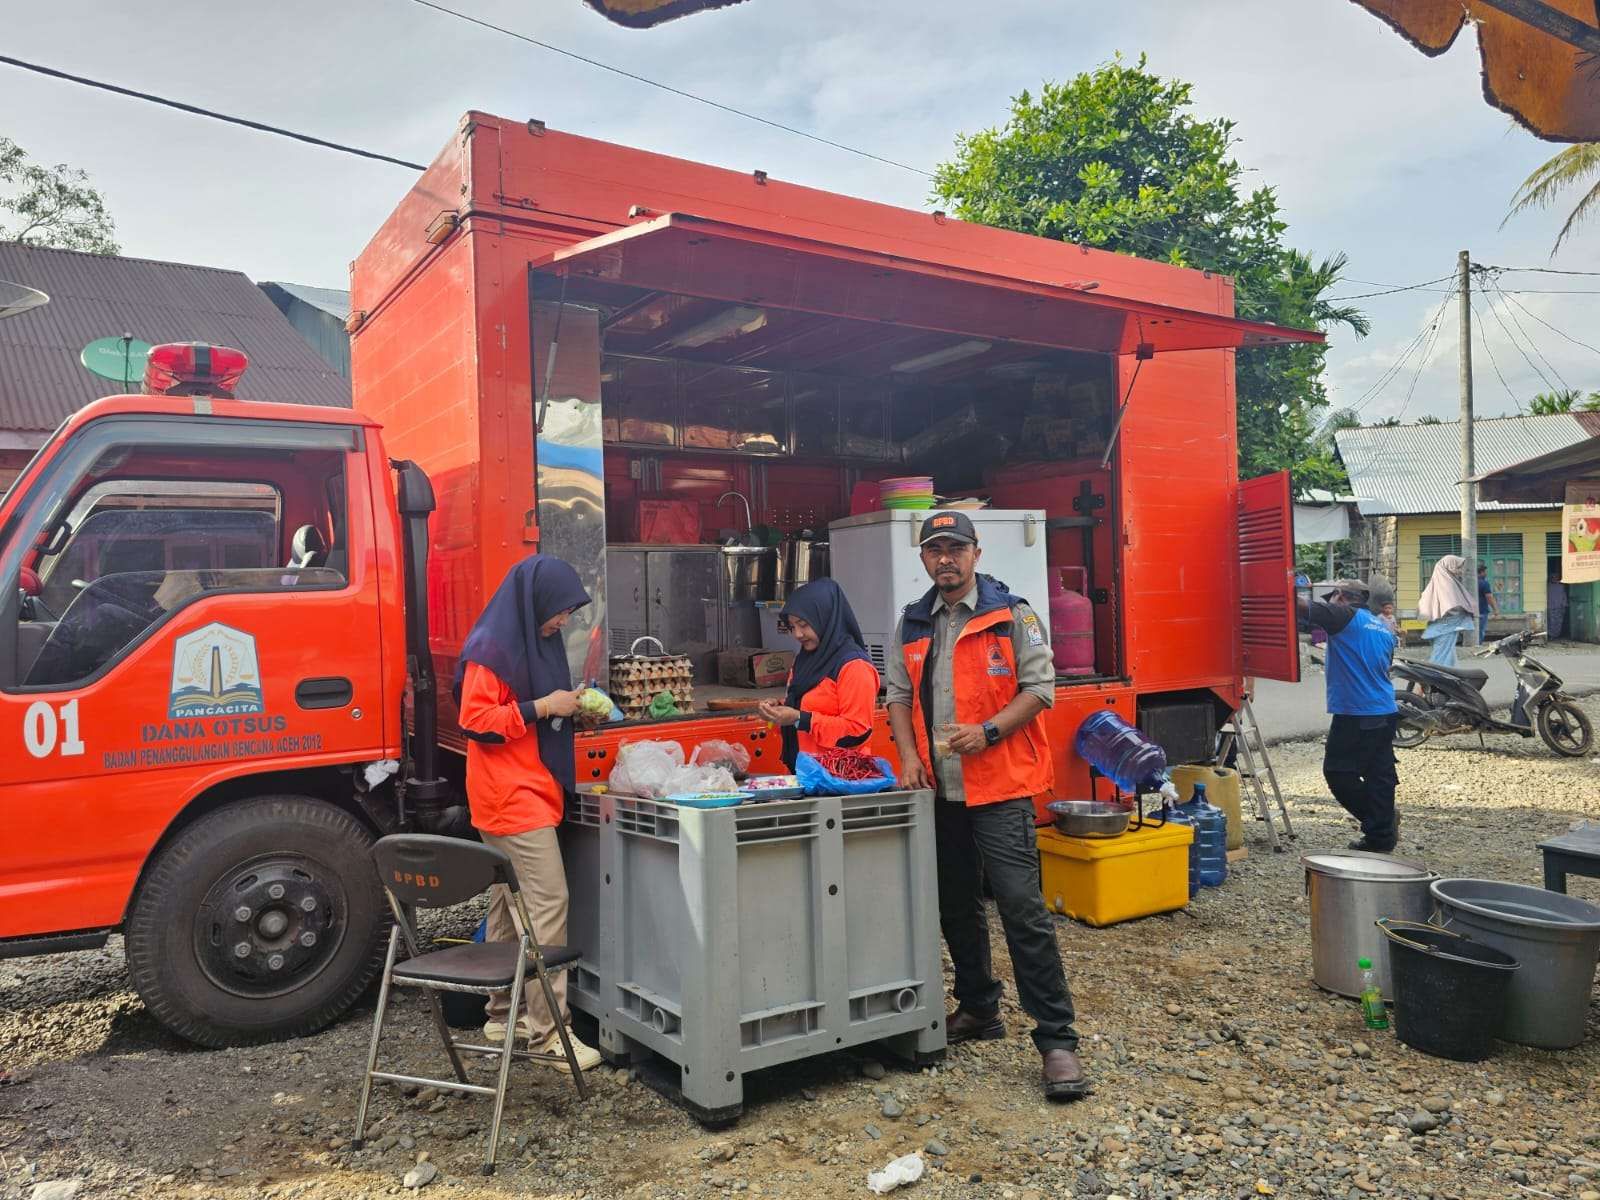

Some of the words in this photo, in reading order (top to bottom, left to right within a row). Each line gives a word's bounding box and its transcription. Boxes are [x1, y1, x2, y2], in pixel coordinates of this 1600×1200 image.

[176, 704, 258, 717] PANCACITA
[24, 699, 84, 758] 01
[143, 721, 205, 742] DANA
[213, 716, 286, 736] OTSUS
[104, 750, 137, 769] BADAN
[277, 736, 300, 752] ACEH
[303, 734, 321, 750] 2012
[394, 871, 440, 888] BPBD
